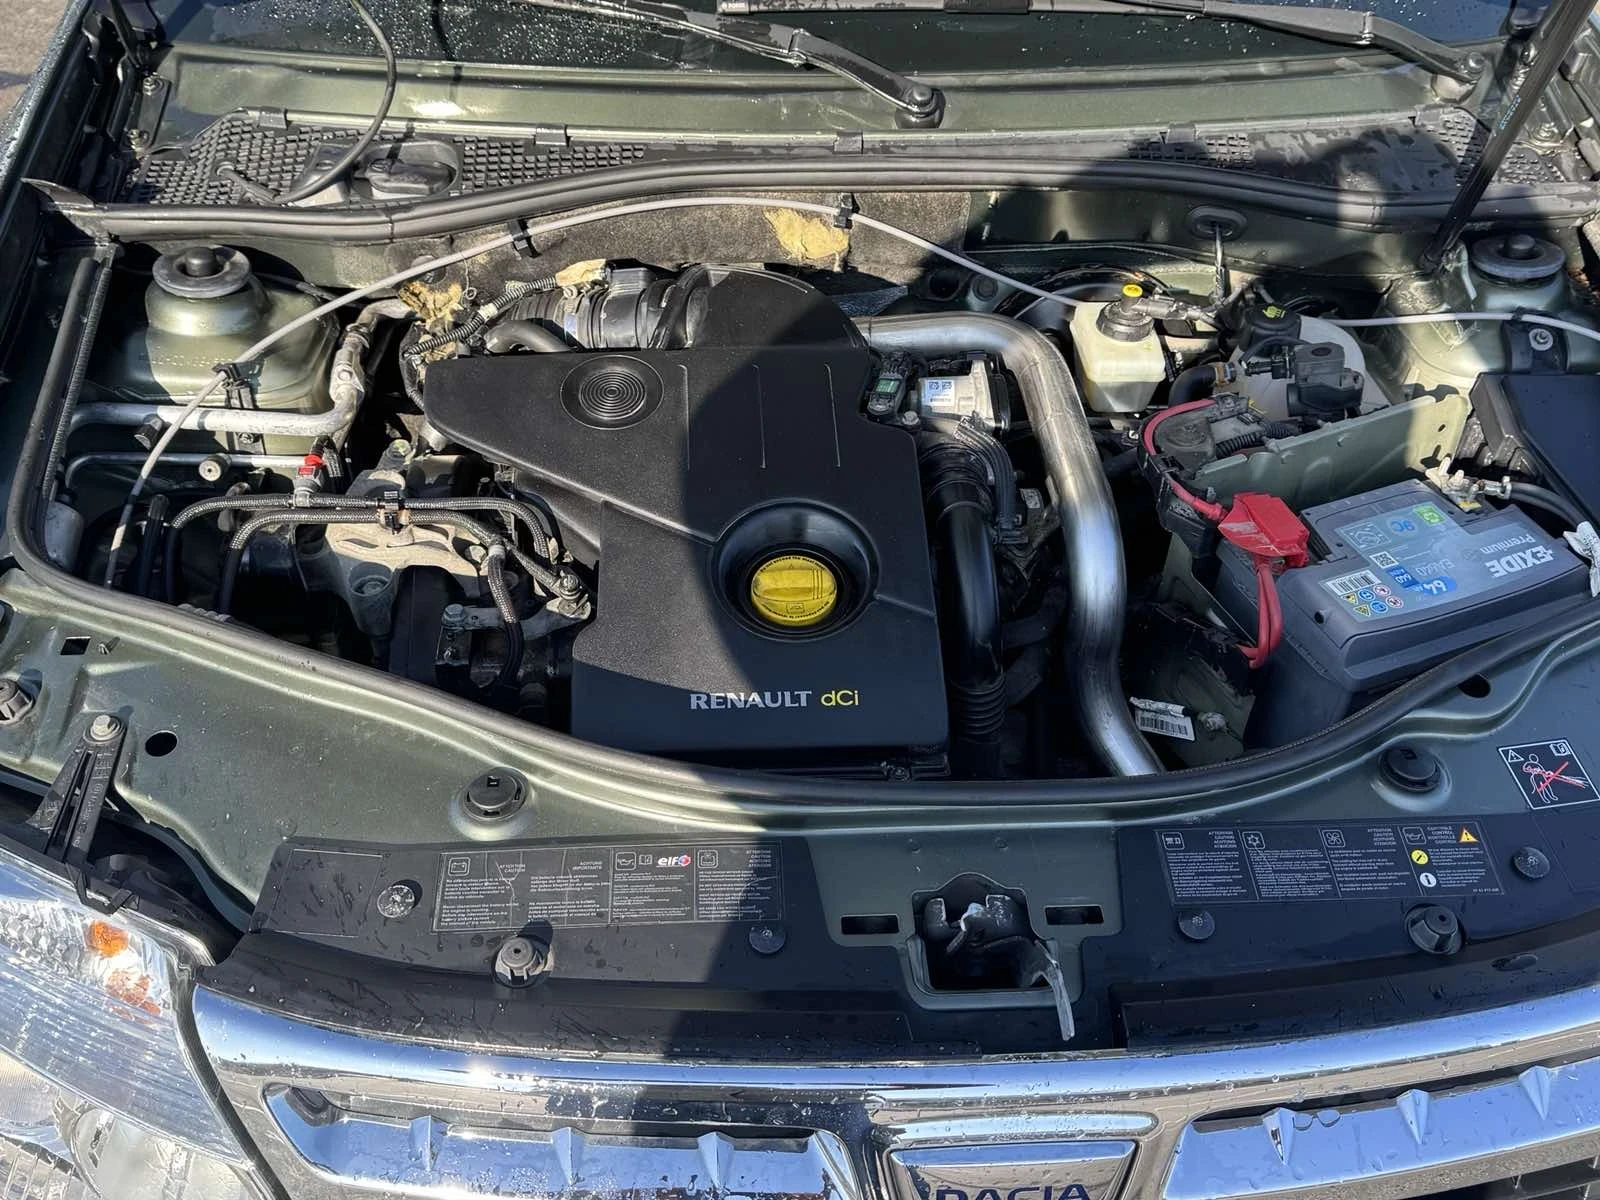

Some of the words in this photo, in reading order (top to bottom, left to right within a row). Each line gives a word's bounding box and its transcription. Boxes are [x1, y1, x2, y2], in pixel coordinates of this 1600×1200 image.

[1480, 533, 1536, 555] Premium
[1485, 545, 1553, 578] EXIDE
[1423, 579, 1447, 595] 64
[689, 690, 812, 710] RENAULT
[820, 689, 859, 707] dCi
[657, 855, 680, 867] elf
